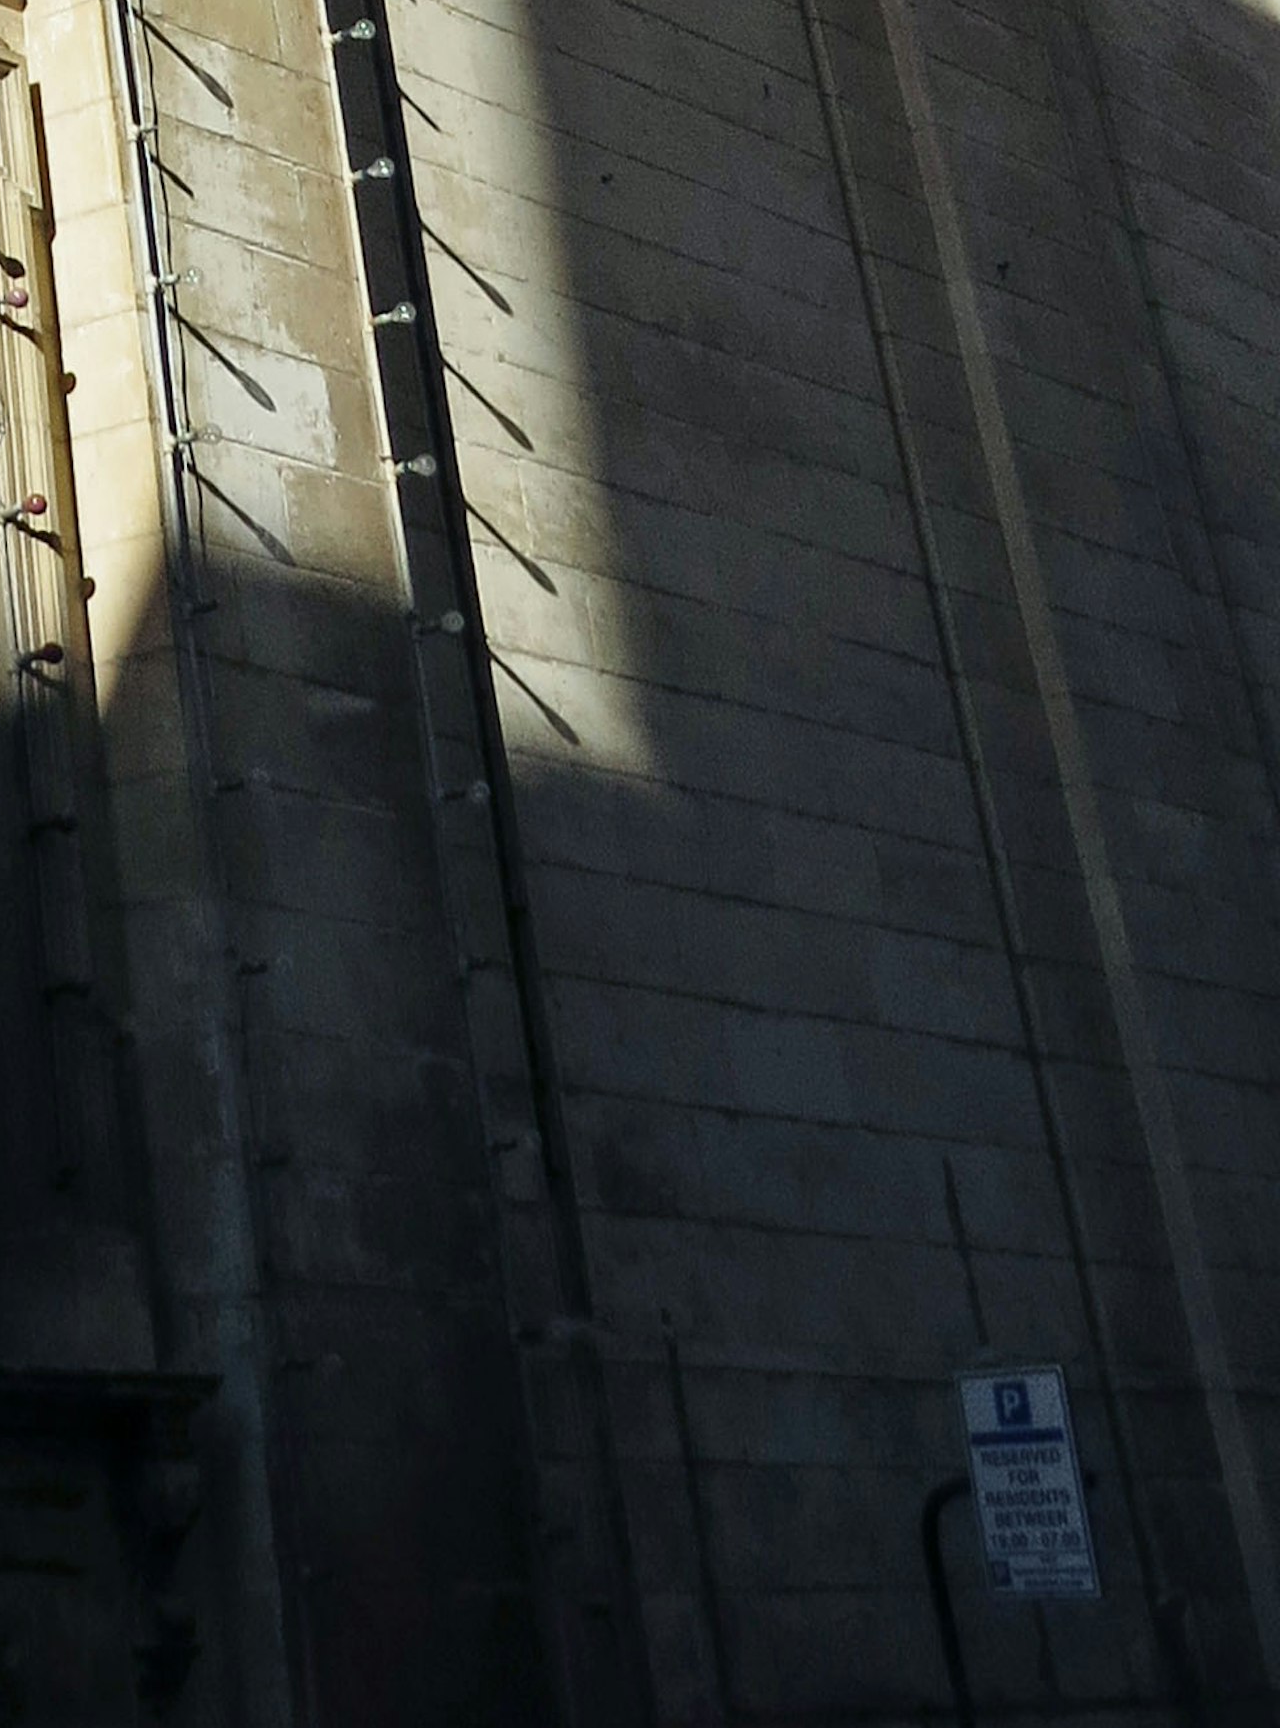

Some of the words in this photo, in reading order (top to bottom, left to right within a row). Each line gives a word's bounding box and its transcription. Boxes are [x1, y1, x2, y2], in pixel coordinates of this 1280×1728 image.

[1002, 1389, 1020, 1418] P
[1008, 1470, 1040, 1485] FOR
[995, 1510, 1068, 1528] BETWEEN
